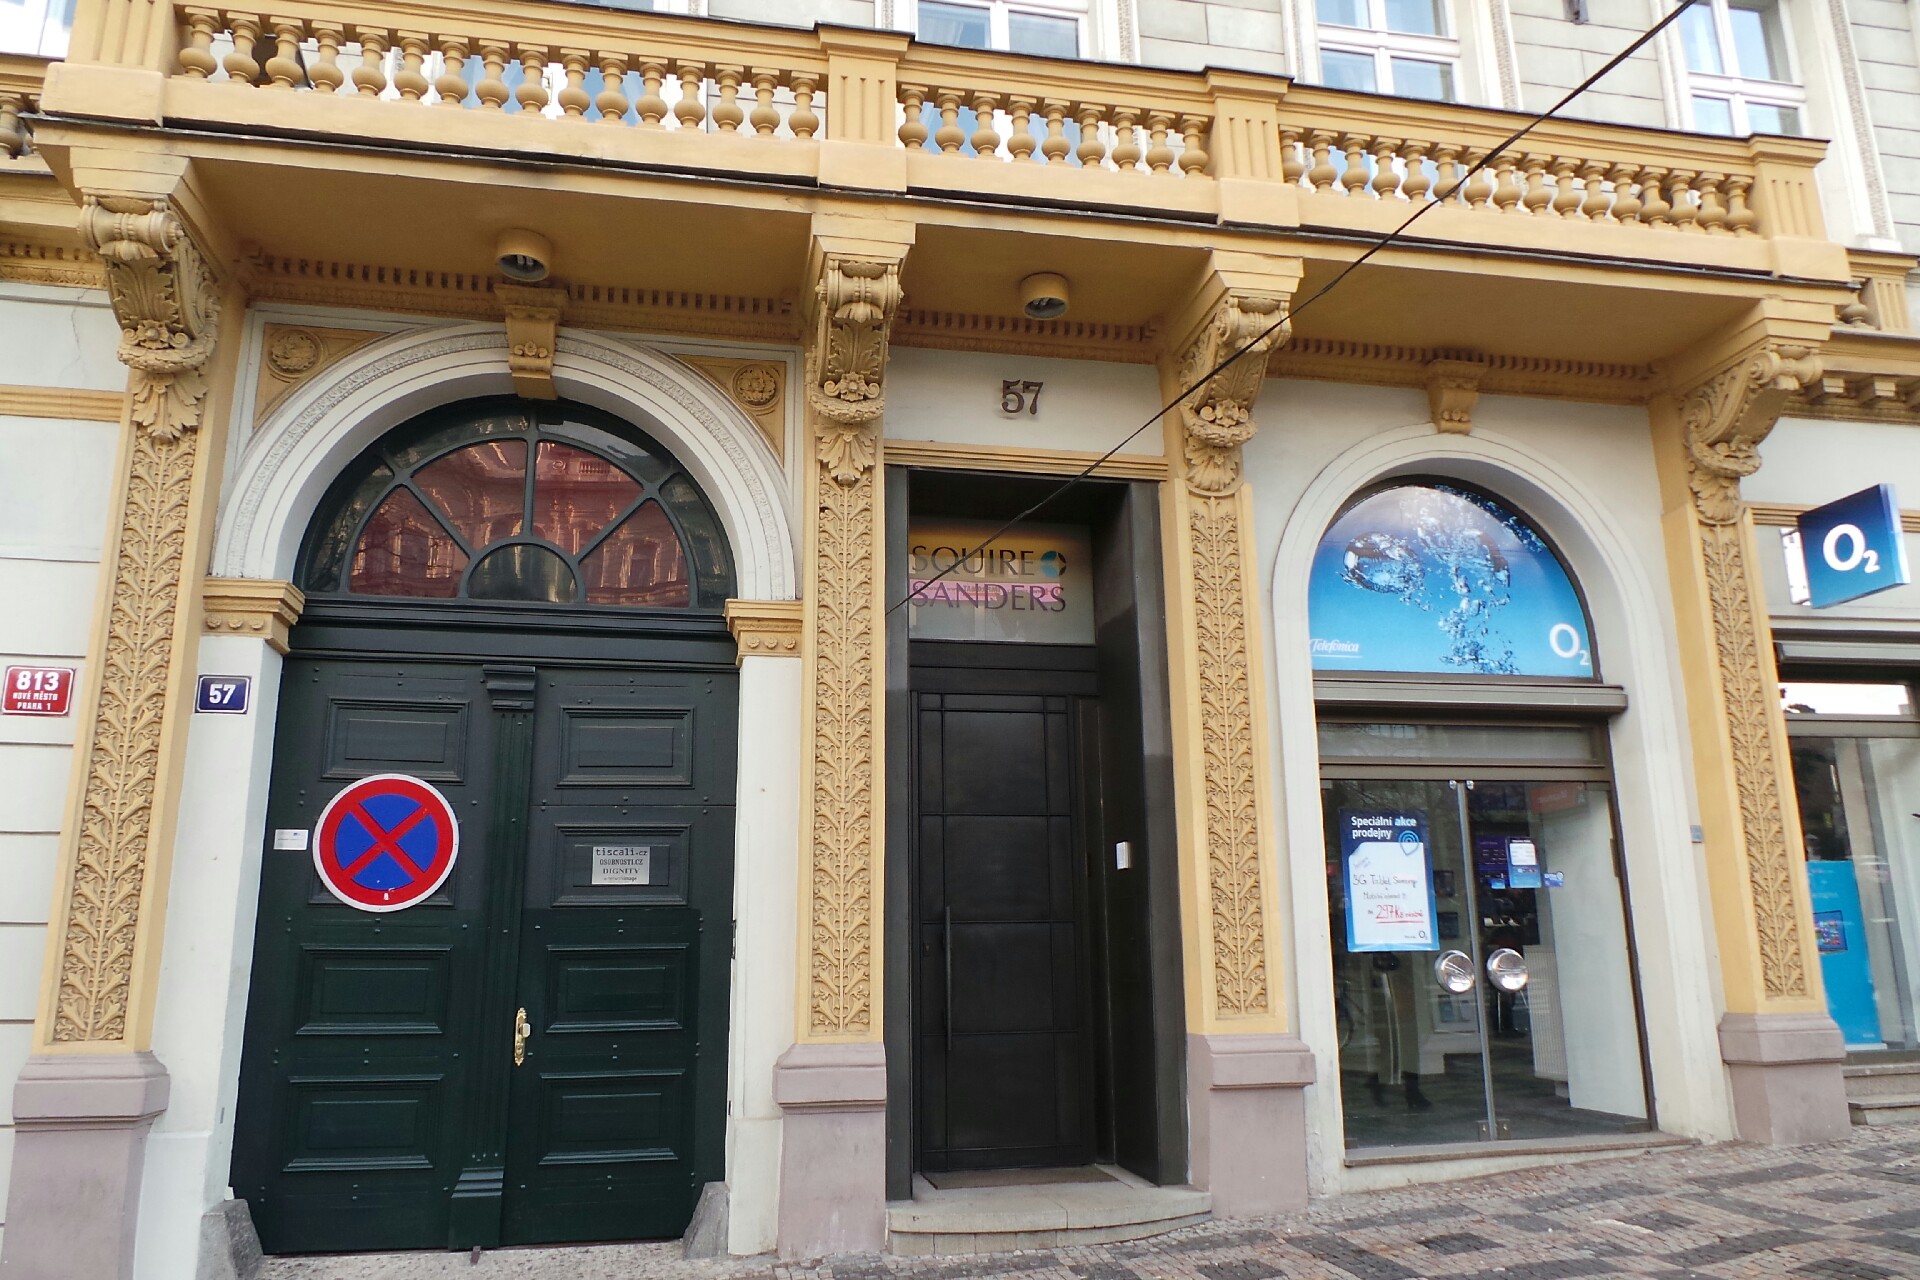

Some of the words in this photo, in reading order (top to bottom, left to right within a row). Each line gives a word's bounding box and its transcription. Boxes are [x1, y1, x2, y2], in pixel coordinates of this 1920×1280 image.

[1001, 379, 1044, 416] 57
[1822, 523, 1880, 573] O2
[912, 545, 1035, 576] SQUIRE
[912, 580, 1067, 613] SANDERS
[1549, 623, 1590, 666] O2
[16, 670, 59, 691] 813
[12, 690, 32, 700] NOVÉ
[208, 683, 236, 705] 57
[17, 701, 42, 710] PRAHA
[46, 702, 52, 711] 1
[1351, 816, 1392, 828] Speciální
[1394, 816, 1417, 827] akce
[1352, 828, 1393, 840] prodejny
[596, 847, 648, 856] tiscali.cz
